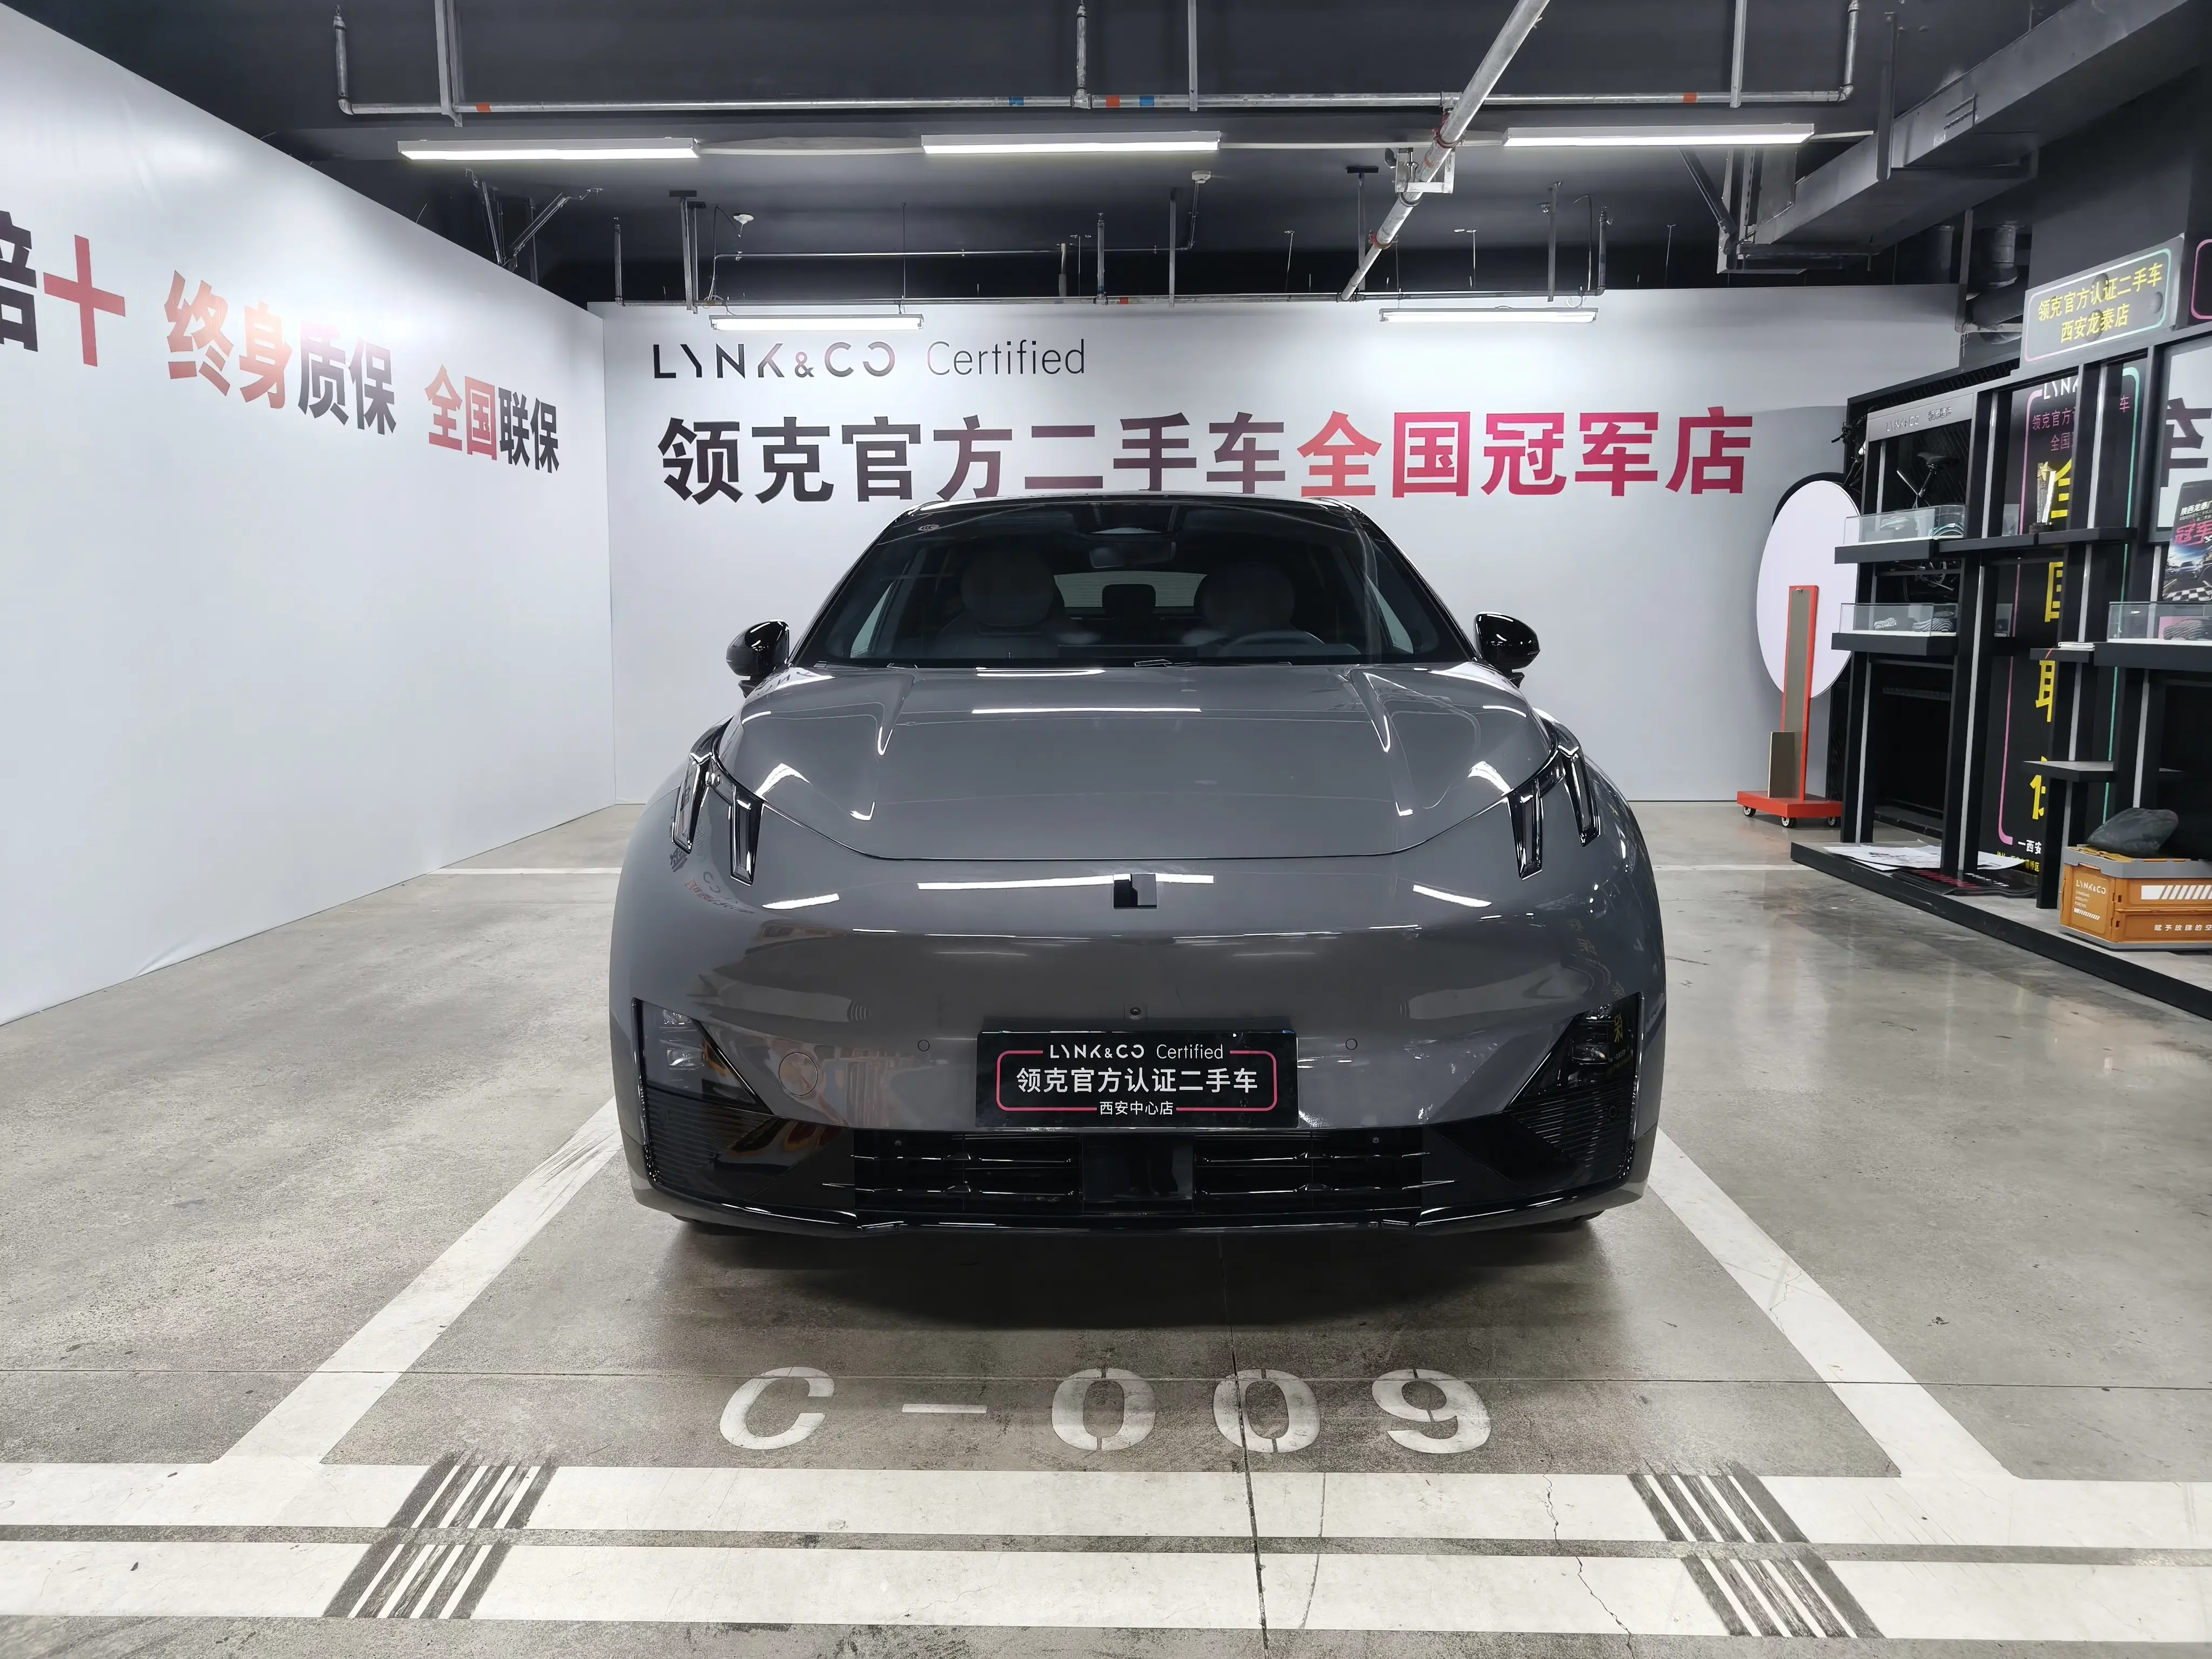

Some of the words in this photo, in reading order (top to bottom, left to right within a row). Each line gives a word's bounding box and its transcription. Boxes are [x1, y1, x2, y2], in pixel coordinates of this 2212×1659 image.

[2038, 262, 2164, 321] 领克官方认证二手车
[2060, 303, 2130, 343] 西安龙泰店
[164, 270, 397, 435] 终身质保
[424, 363, 559, 473] 全国联保
[653, 341, 896, 379] LYNK&CO
[926, 339, 1085, 376] Certified
[2032, 407, 2076, 430] 领克官方
[2051, 432, 2074, 451] 全国
[657, 406, 1754, 505] 领克官方二手车全国冠军店
[2076, 879, 2106, 895] LYNK&CO
[1050, 1044, 1145, 1059] LYNK&CO
[1156, 1044, 1224, 1059] Certified
[1016, 1067, 1258, 1094] 领克官方认证二手车
[1099, 1101, 1174, 1115] 西安中心店
